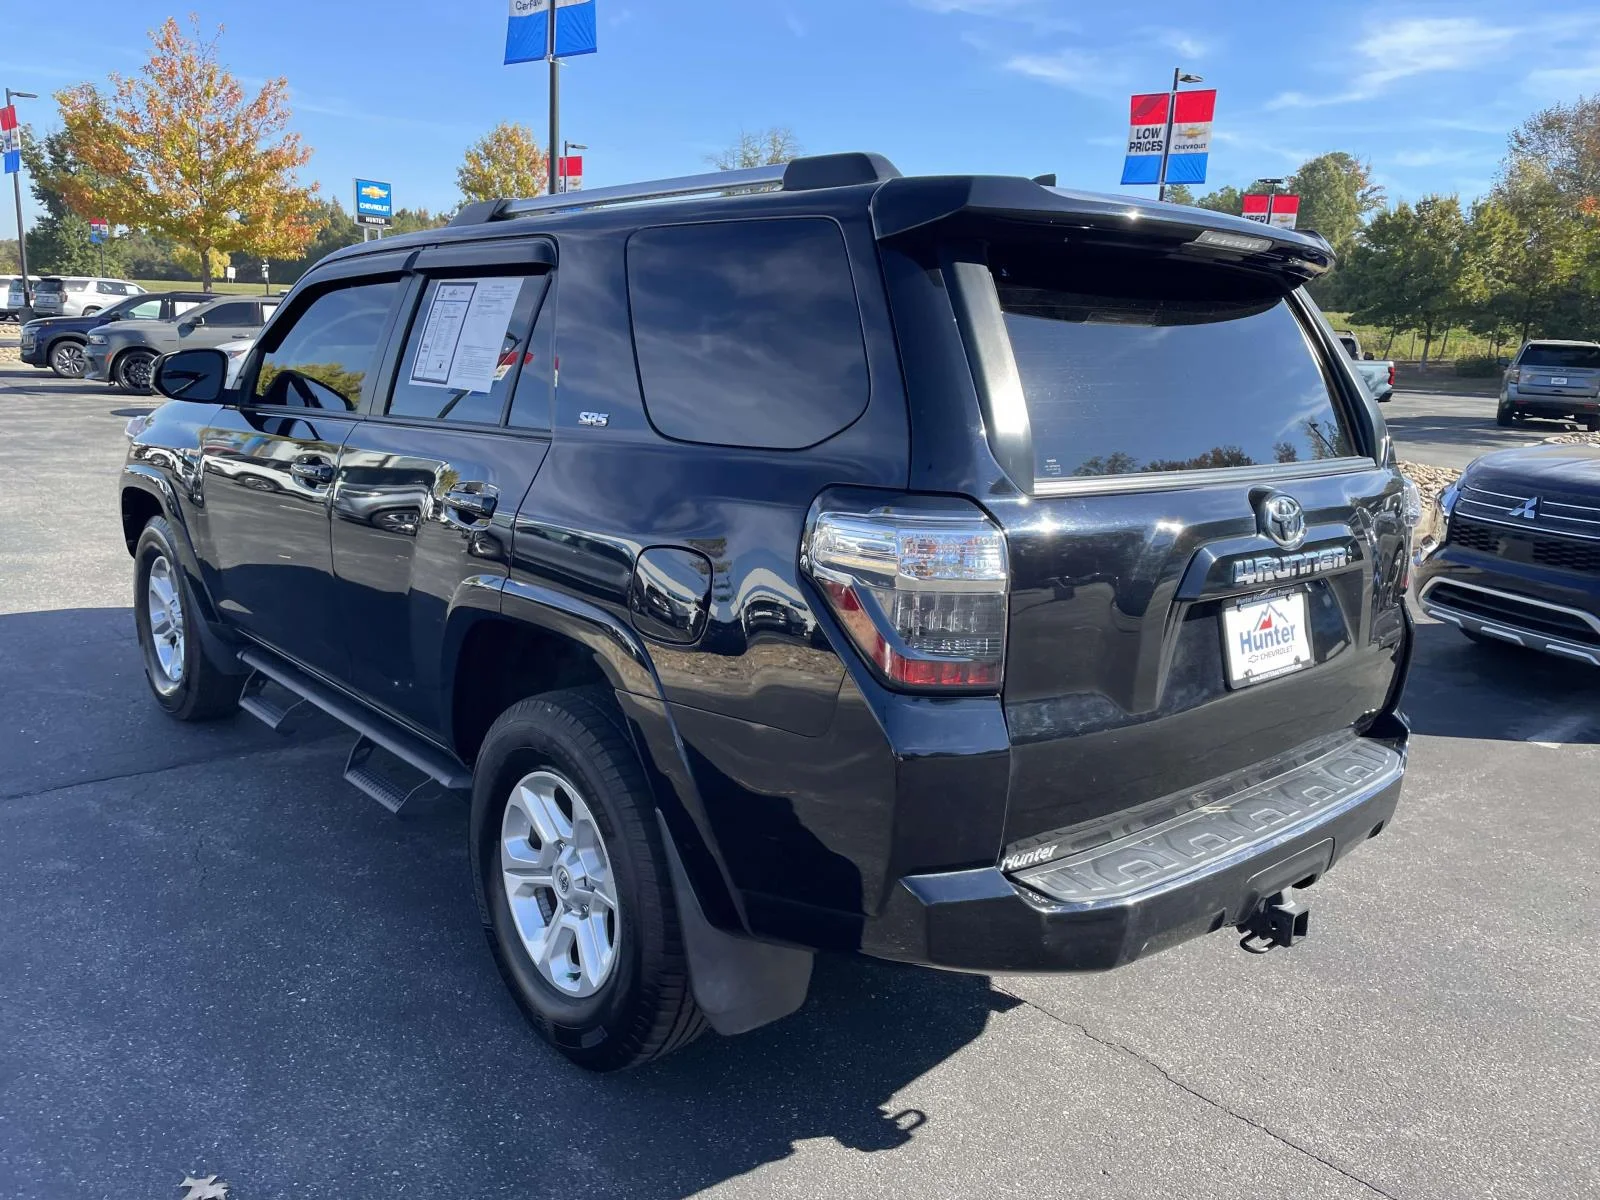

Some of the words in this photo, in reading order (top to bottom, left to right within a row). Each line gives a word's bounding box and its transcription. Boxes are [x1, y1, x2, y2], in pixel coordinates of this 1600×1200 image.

[1136, 127, 1161, 140] LOW
[1129, 140, 1163, 152] PRICES
[360, 202, 389, 211] CHEVROLET
[578, 411, 609, 427] SR5
[1239, 623, 1296, 655] Hunter
[1260, 645, 1294, 660] CHEVROLET
[1000, 845, 1058, 871] Hunter
